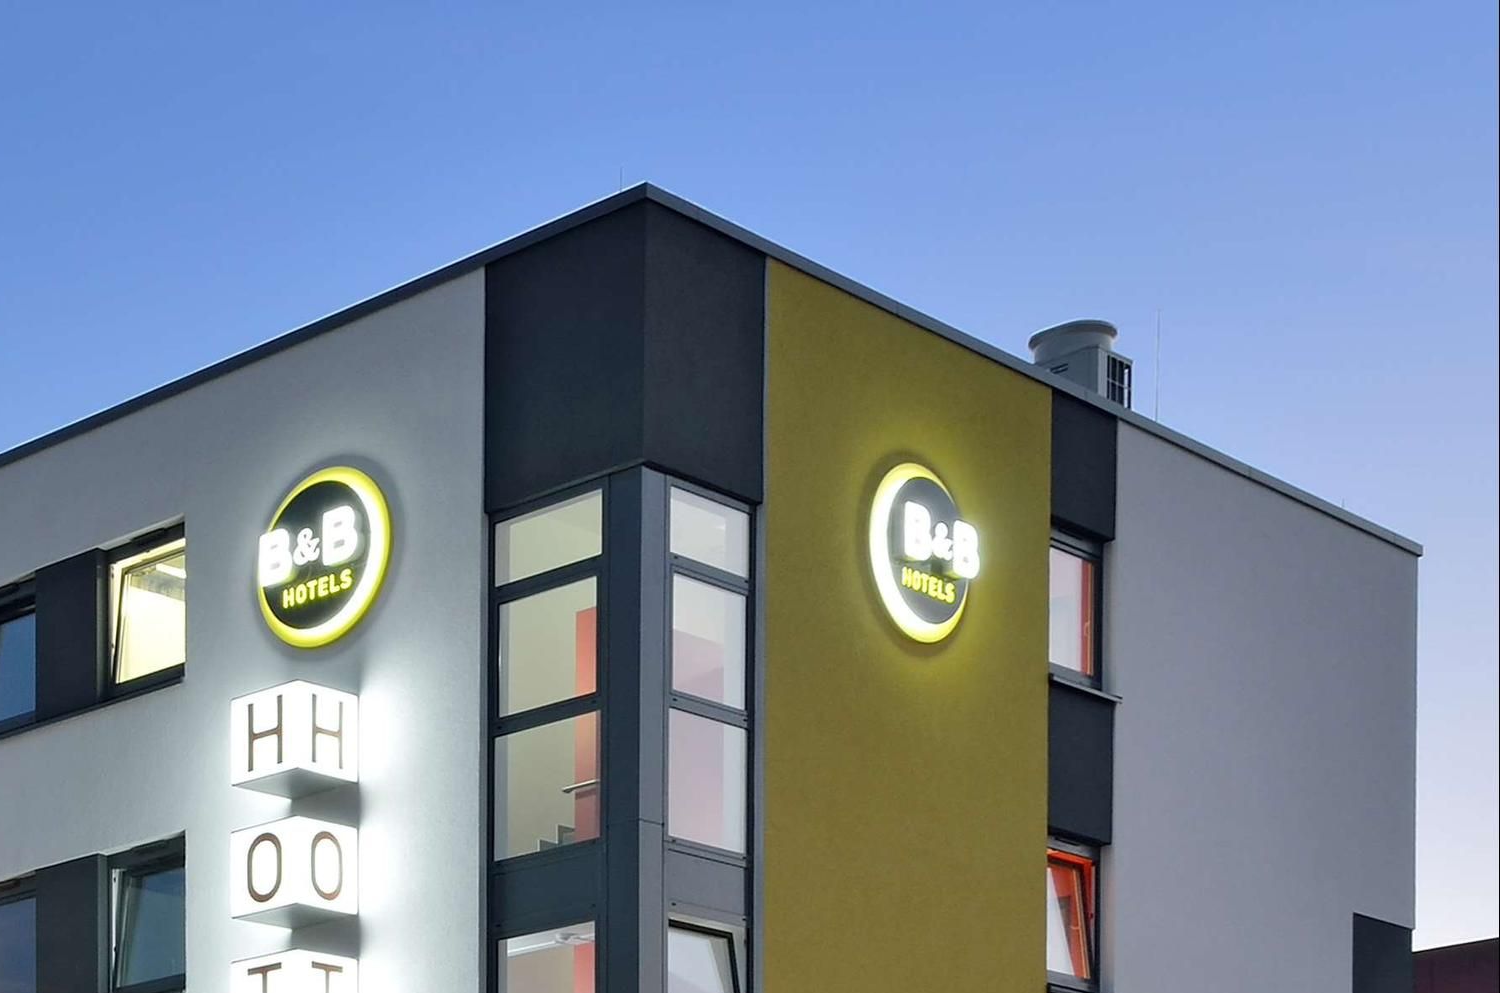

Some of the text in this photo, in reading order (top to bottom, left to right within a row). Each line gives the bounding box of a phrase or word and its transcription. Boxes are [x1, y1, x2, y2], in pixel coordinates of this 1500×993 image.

[258, 505, 358, 587] B&B
[904, 500, 980, 579] B&B
[282, 568, 352, 609] HOTELS
[902, 566, 956, 604] HOTELS
